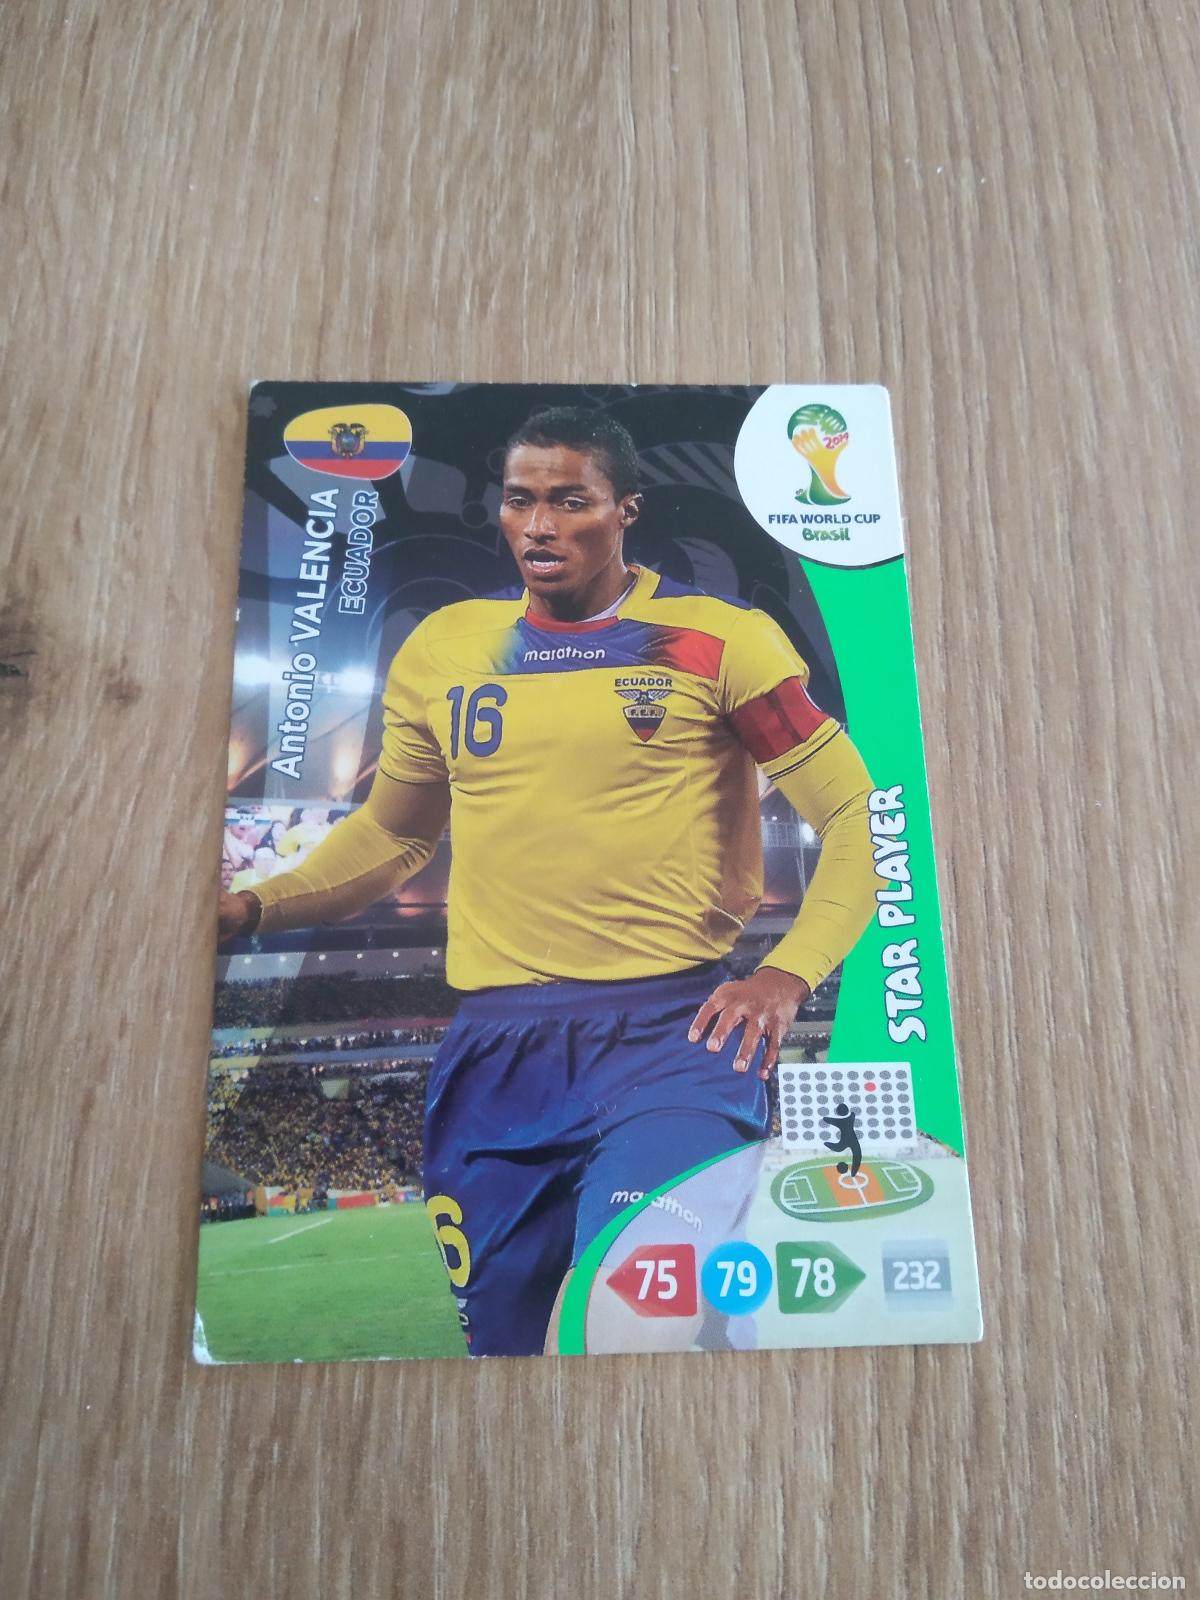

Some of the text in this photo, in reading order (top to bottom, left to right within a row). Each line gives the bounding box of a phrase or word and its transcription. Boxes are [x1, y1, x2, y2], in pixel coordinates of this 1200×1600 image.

[768, 514, 880, 524] FIFA WORLD CUP
[802, 527, 851, 541] Brasil
[338, 489, 379, 615] ECUADOR
[272, 487, 340, 780] Antonio VALENCIA
[524, 645, 606, 662] marathon
[614, 677, 673, 687] ECUADOR
[447, 683, 508, 760] 16
[867, 784, 927, 1043] STAR PLAYER
[635, 1260, 678, 1299] 75
[716, 1261, 757, 1297] 79
[791, 1258, 836, 1297] 78
[892, 1261, 941, 1290] 232
